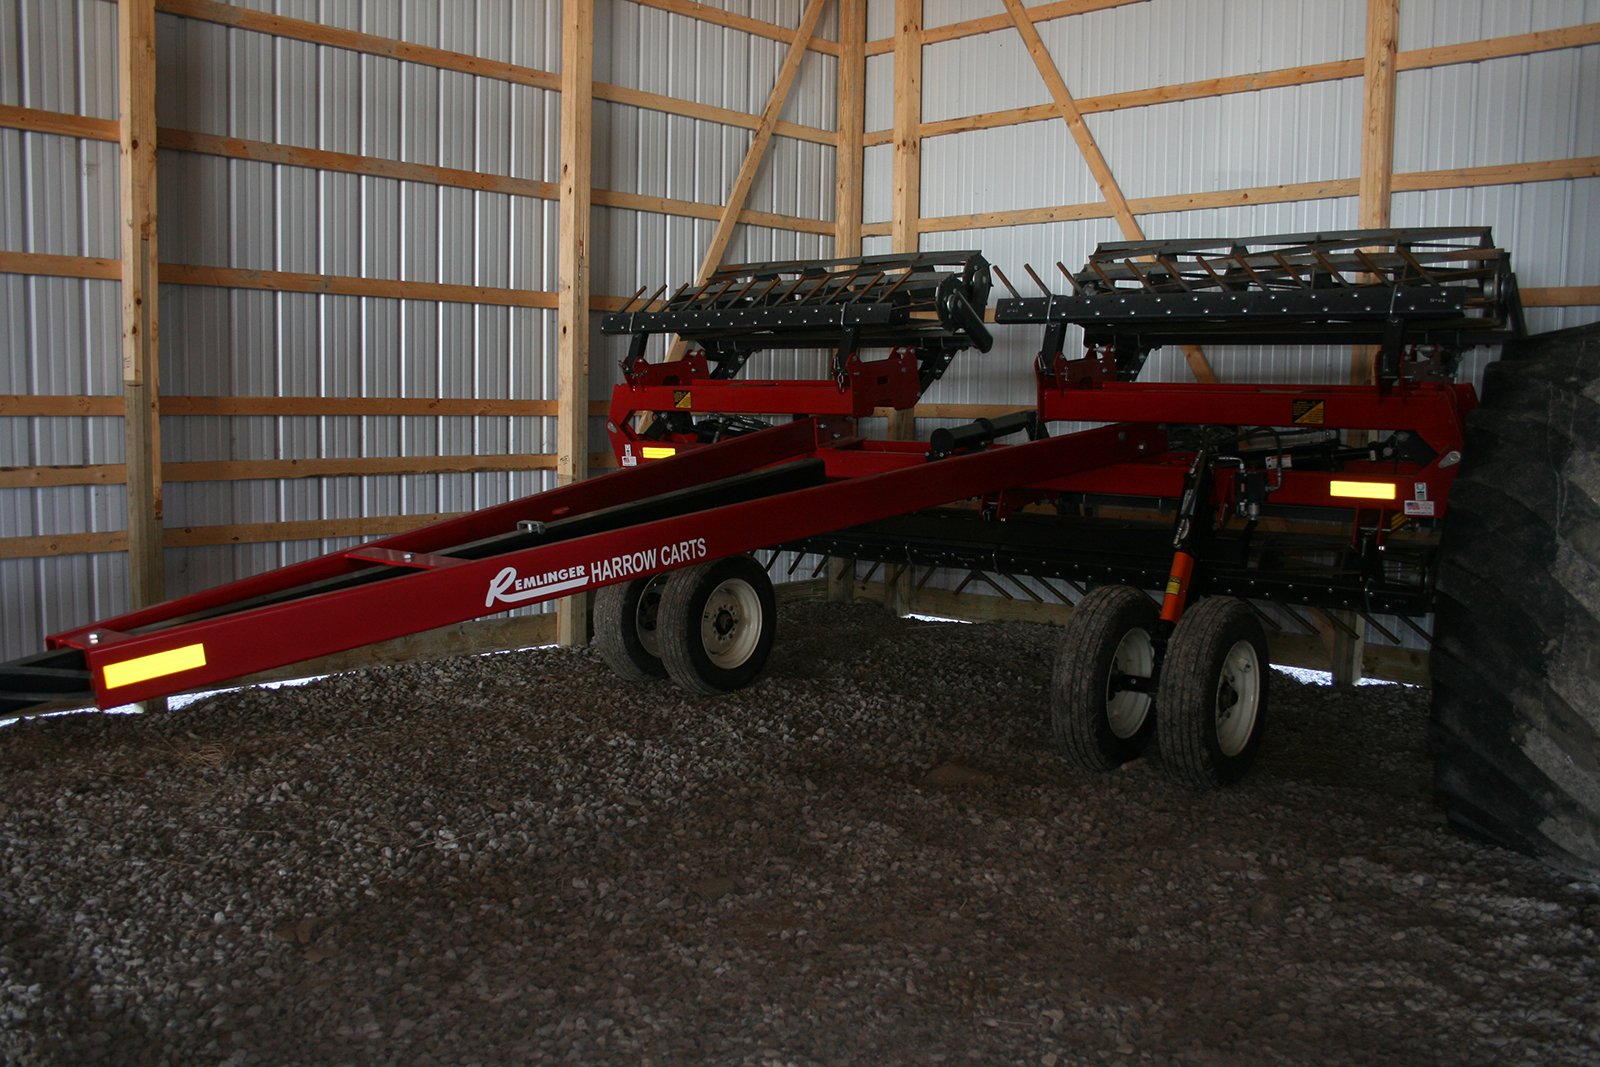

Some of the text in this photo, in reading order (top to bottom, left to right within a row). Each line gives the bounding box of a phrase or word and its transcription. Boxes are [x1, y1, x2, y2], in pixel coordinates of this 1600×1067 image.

[485, 537, 707, 608] REMLINGER HARROW CARTS
